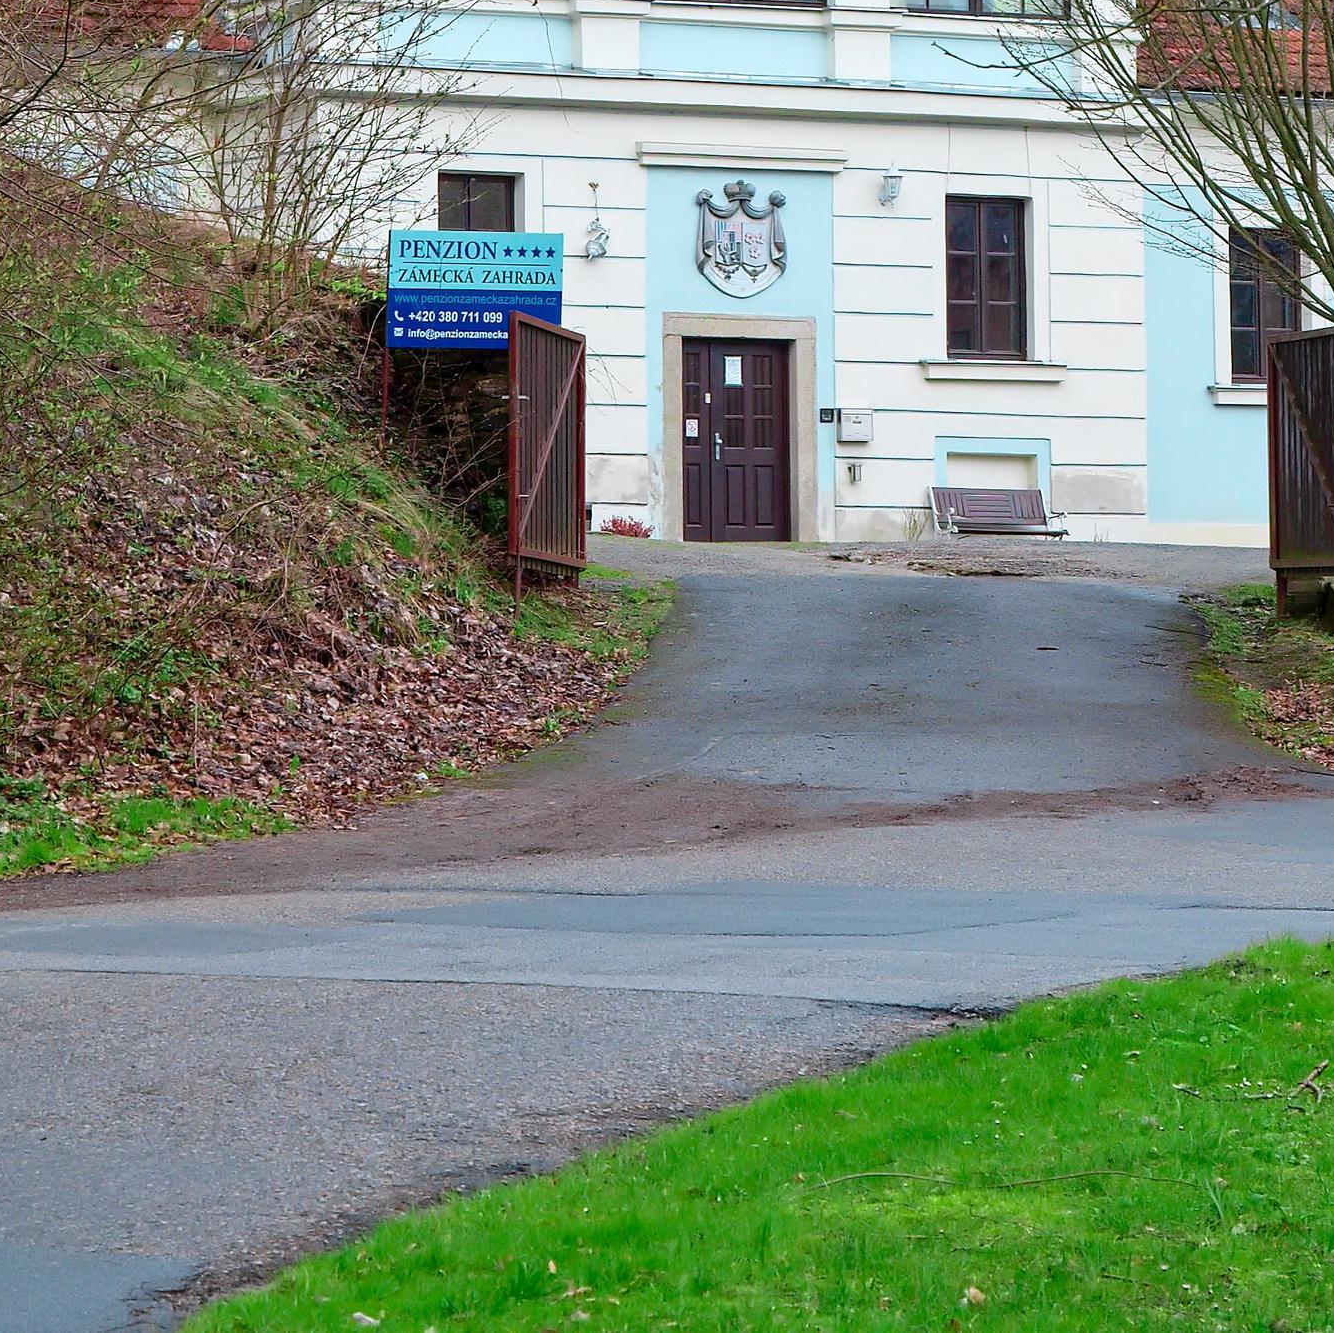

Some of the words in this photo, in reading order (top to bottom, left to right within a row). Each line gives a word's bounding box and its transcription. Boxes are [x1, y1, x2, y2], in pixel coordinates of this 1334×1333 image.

[399, 240, 498, 260] PENZION
[398, 266, 474, 283] ZÁMECKÁ
[482, 270, 556, 285] ZAHRADA
[394, 294, 557, 306] www.penzionzameckazahrada.cz
[408, 311, 435, 322] +420
[438, 311, 458, 323] 380
[461, 311, 479, 323] 711
[483, 312, 503, 323] 099
